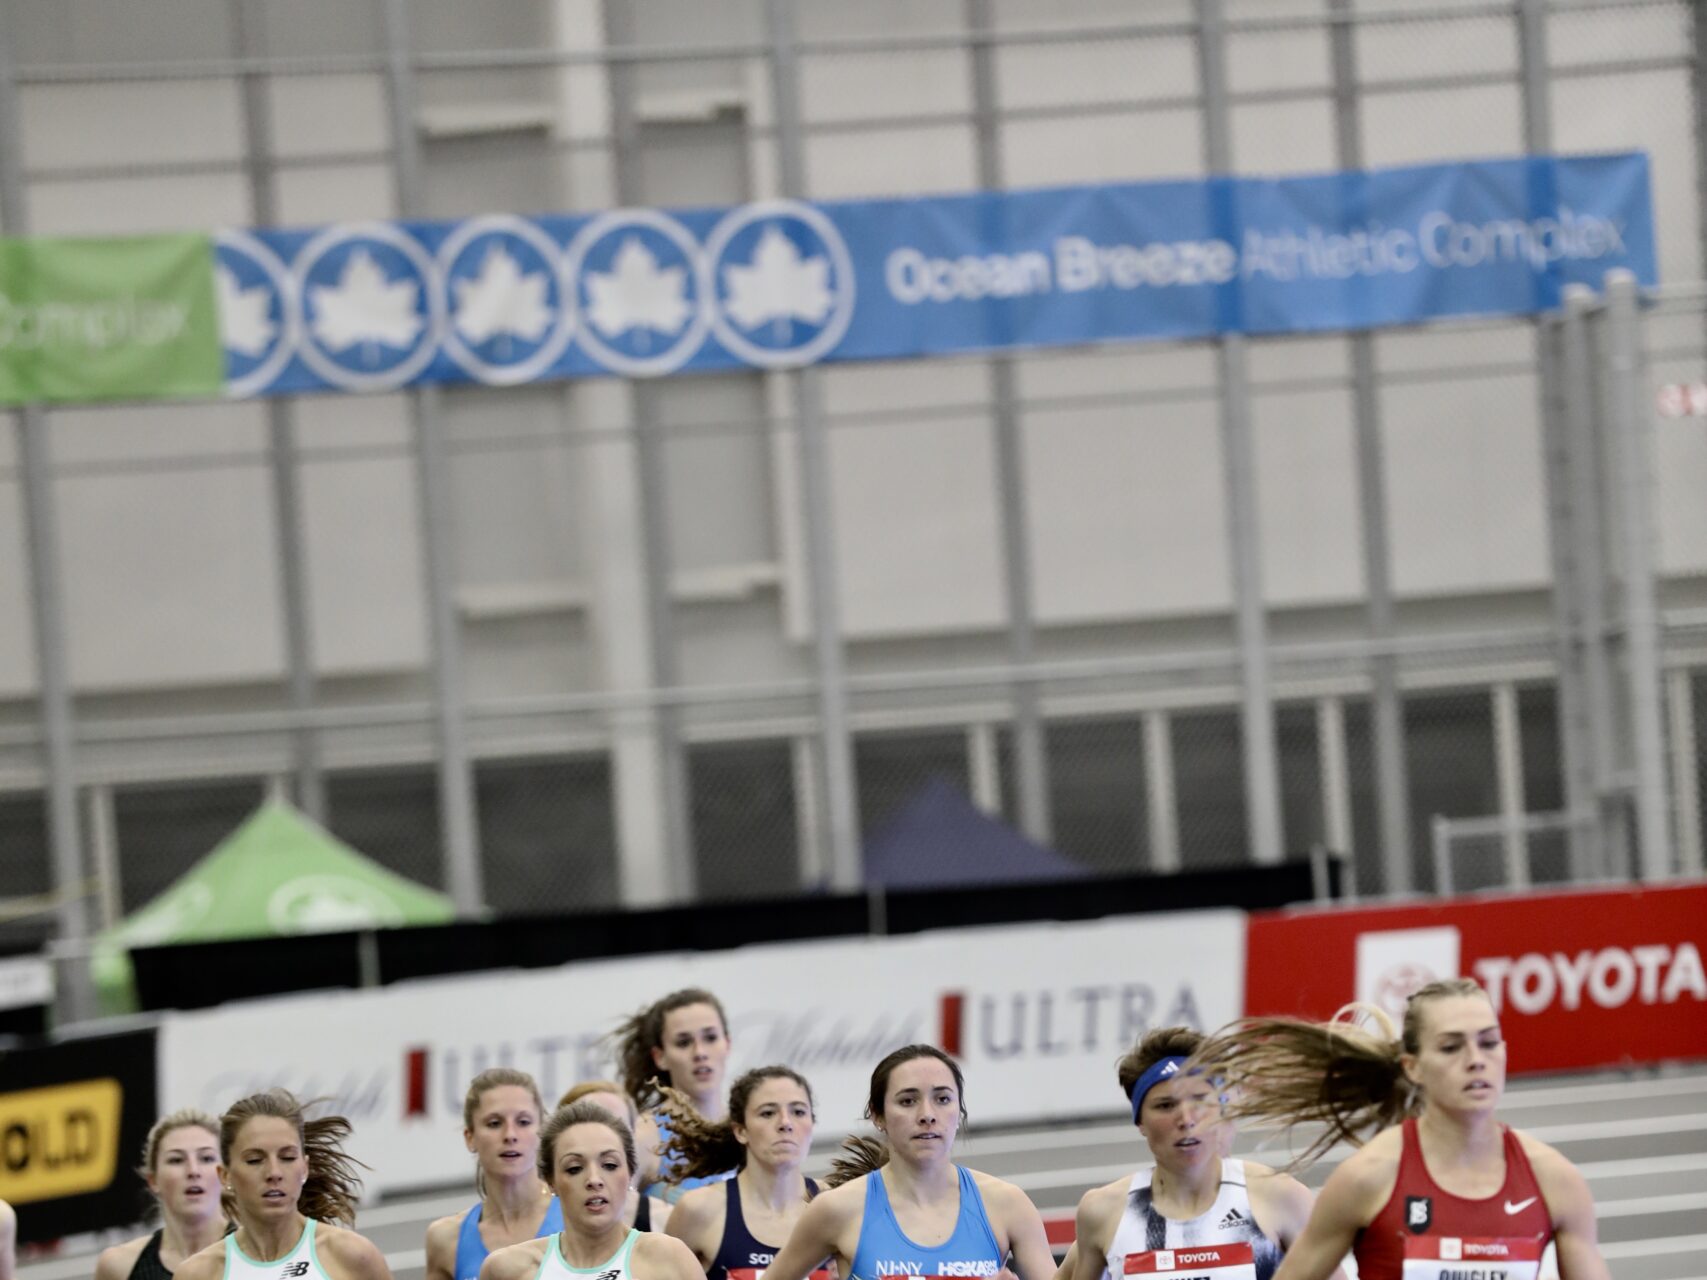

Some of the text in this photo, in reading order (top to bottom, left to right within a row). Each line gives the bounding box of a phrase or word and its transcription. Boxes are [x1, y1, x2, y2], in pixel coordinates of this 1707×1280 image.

[886, 205, 1628, 305] Ocean Breeze Athletic Complex
[1474, 942, 1707, 1014] TOYOTA
[979, 977, 1206, 1060] ULTRA
[0, 1110, 95, 1174] OLD
[1177, 1251, 1221, 1264] TOYOTA
[1464, 1243, 1509, 1256] TOYOTA
